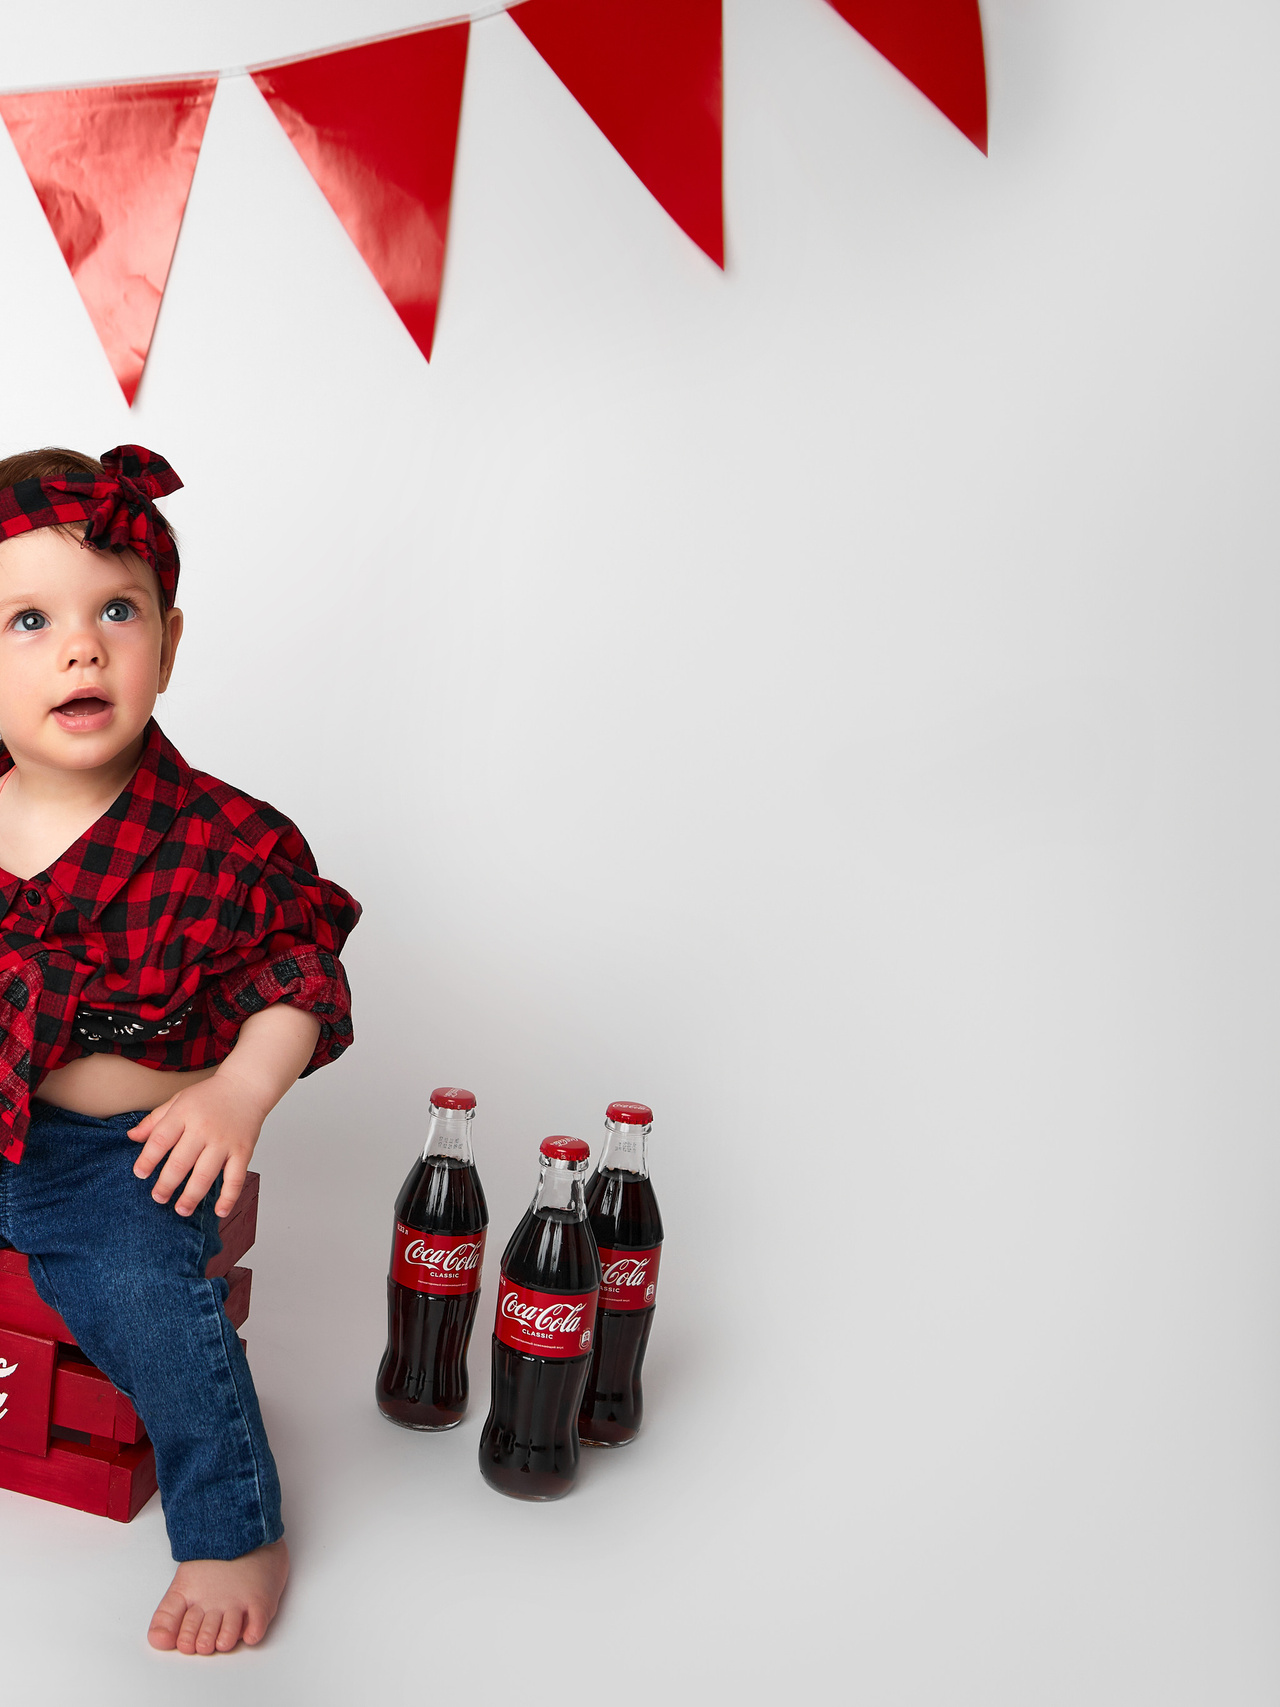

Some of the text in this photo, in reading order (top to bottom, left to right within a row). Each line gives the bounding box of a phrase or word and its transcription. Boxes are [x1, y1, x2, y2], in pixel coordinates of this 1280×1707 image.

[404, 1239, 483, 1272] Coca-Cola
[429, 1271, 460, 1279] CLASSIC
[601, 1257, 652, 1287] -Cola
[600, 1285, 621, 1293] ASSIC
[501, 1292, 588, 1334] Coca-Cola
[521, 1328, 554, 1340] CLASSIC
